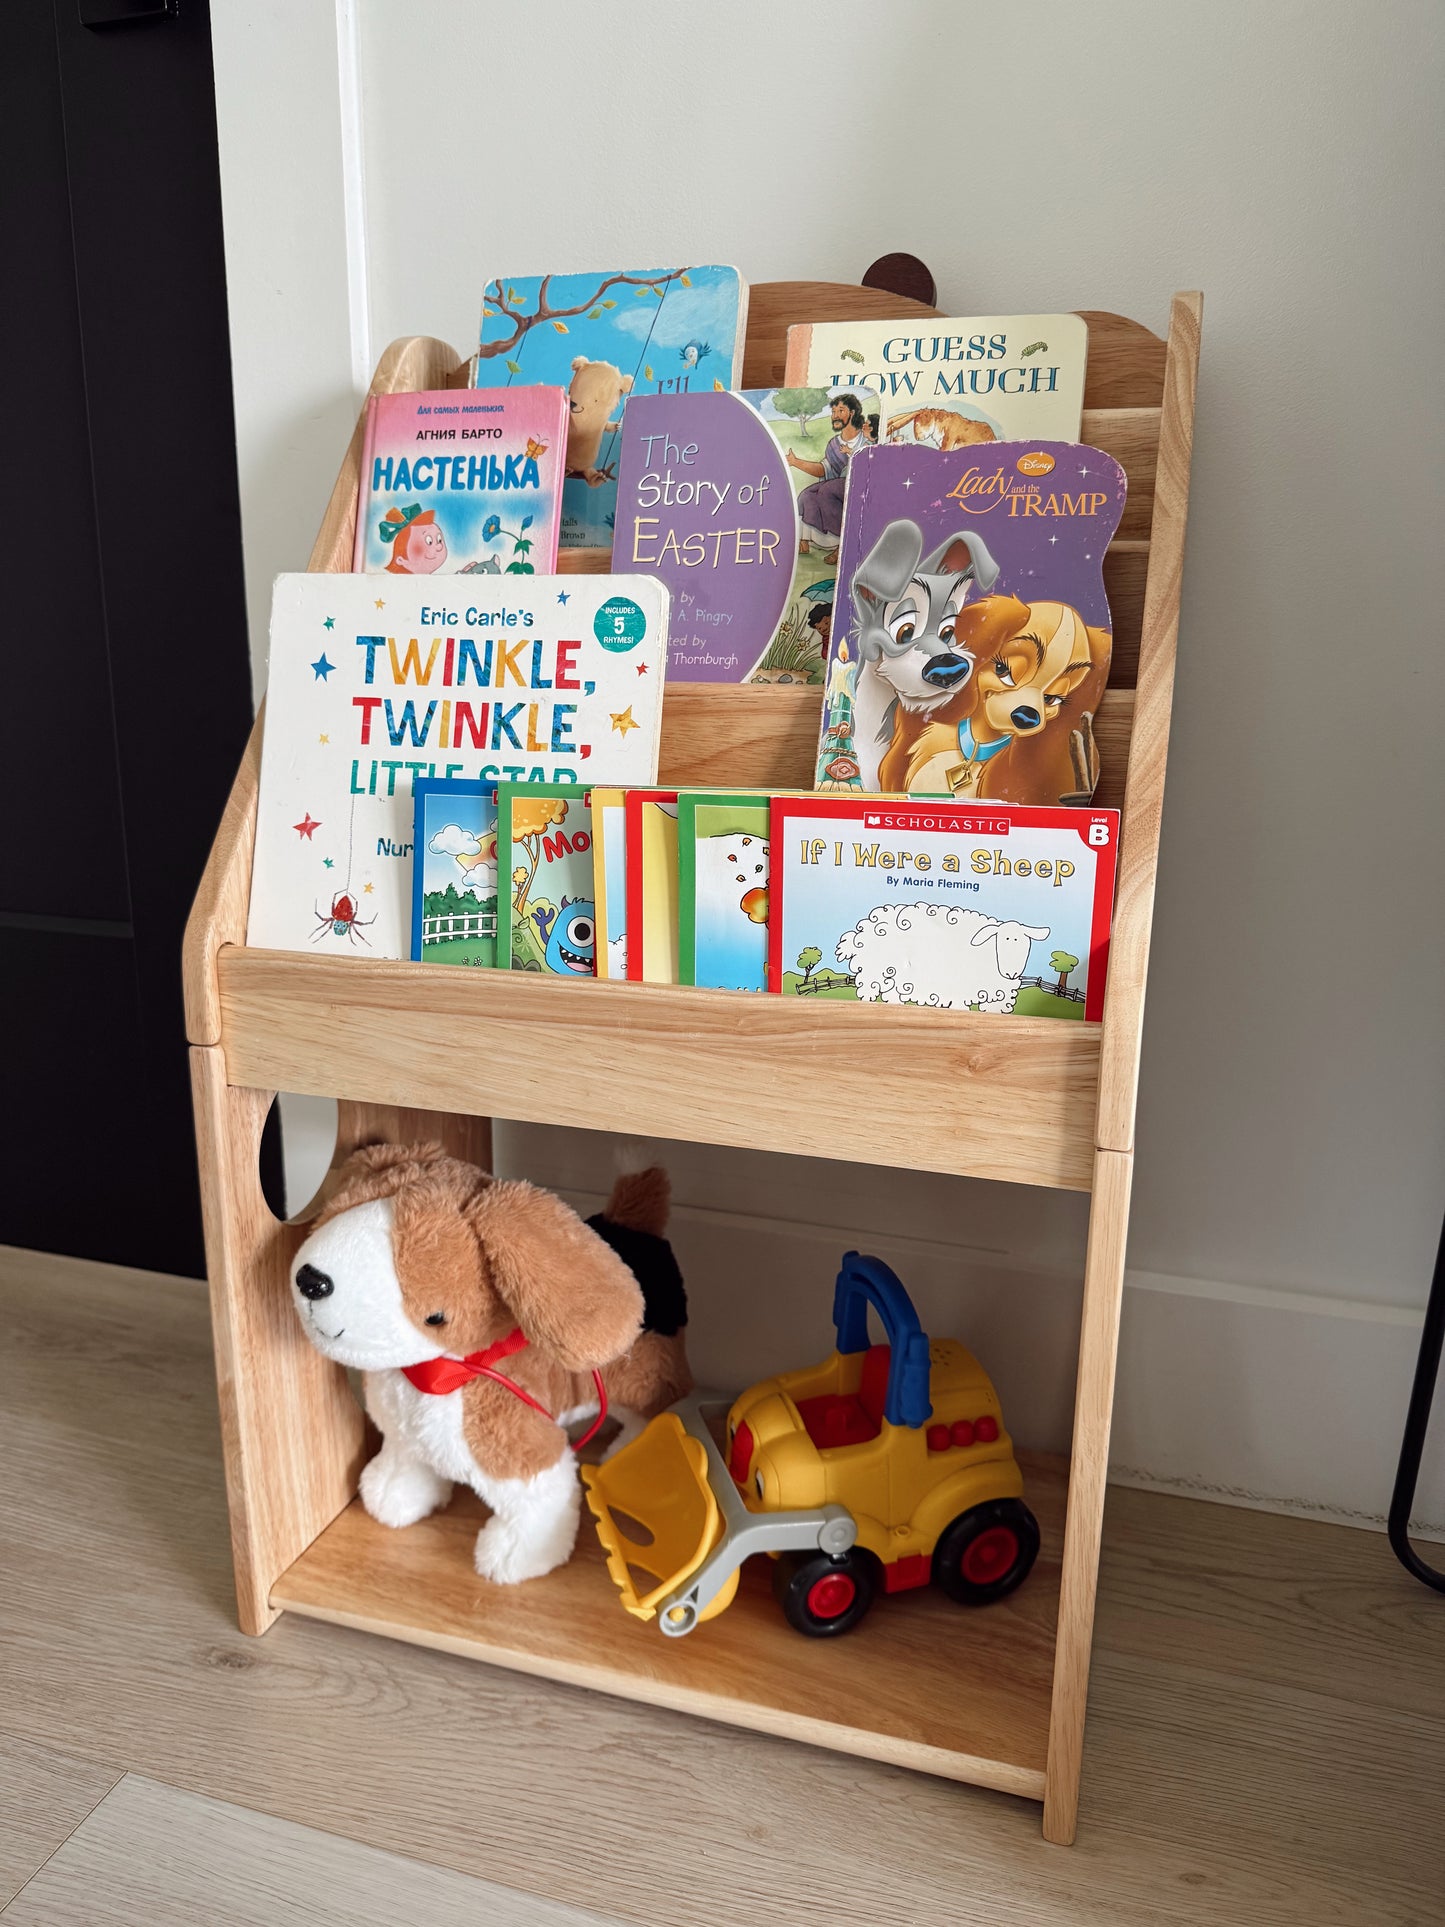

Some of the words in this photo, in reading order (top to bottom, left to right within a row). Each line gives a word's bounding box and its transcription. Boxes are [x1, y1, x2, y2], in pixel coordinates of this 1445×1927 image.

[882, 334, 1007, 363] GUESS
[933, 367, 1061, 396] MUCH
[417, 405, 431, 414] Для
[434, 406, 459, 414] самых
[461, 405, 505, 413] маленьких
[416, 429, 456, 440] АГНИЯ
[461, 428, 503, 440] БАРТО
[640, 433, 700, 469] The
[372, 454, 540, 492] НАСТЕНЬКА
[1020, 458, 1053, 471] Disney
[637, 471, 731, 515] Story
[737, 474, 770, 506] of
[945, 467, 1014, 514] Lady
[1011, 485, 1026, 494] and
[1027, 484, 1040, 494] the
[1005, 493, 1108, 517] TRAMP
[632, 515, 781, 569] EASTER
[680, 591, 696, 607] by
[420, 606, 459, 626] Eric
[465, 606, 534, 627] Carle's
[604, 606, 636, 614] INCLUDES
[677, 608, 689, 621] A.
[695, 608, 734, 626] Pingry
[614, 616, 625, 635] 5
[603, 636, 634, 644] RHYMES!
[692, 634, 707, 650] by
[356, 635, 596, 697] TWINKLE,
[673, 652, 739, 670] Thornburgh
[352, 696, 592, 760] TWINKLE,
[884, 816, 1007, 832] SCHOLASTIC
[1088, 823, 1110, 846] B
[800, 838, 827, 865] If
[834, 841, 844, 866] I
[852, 842, 932, 872] Were
[942, 854, 960, 872] a
[970, 848, 1076, 887] Sheep
[886, 875, 899, 887] By
[903, 876, 934, 888] Maria
[937, 878, 980, 892] Fleming
